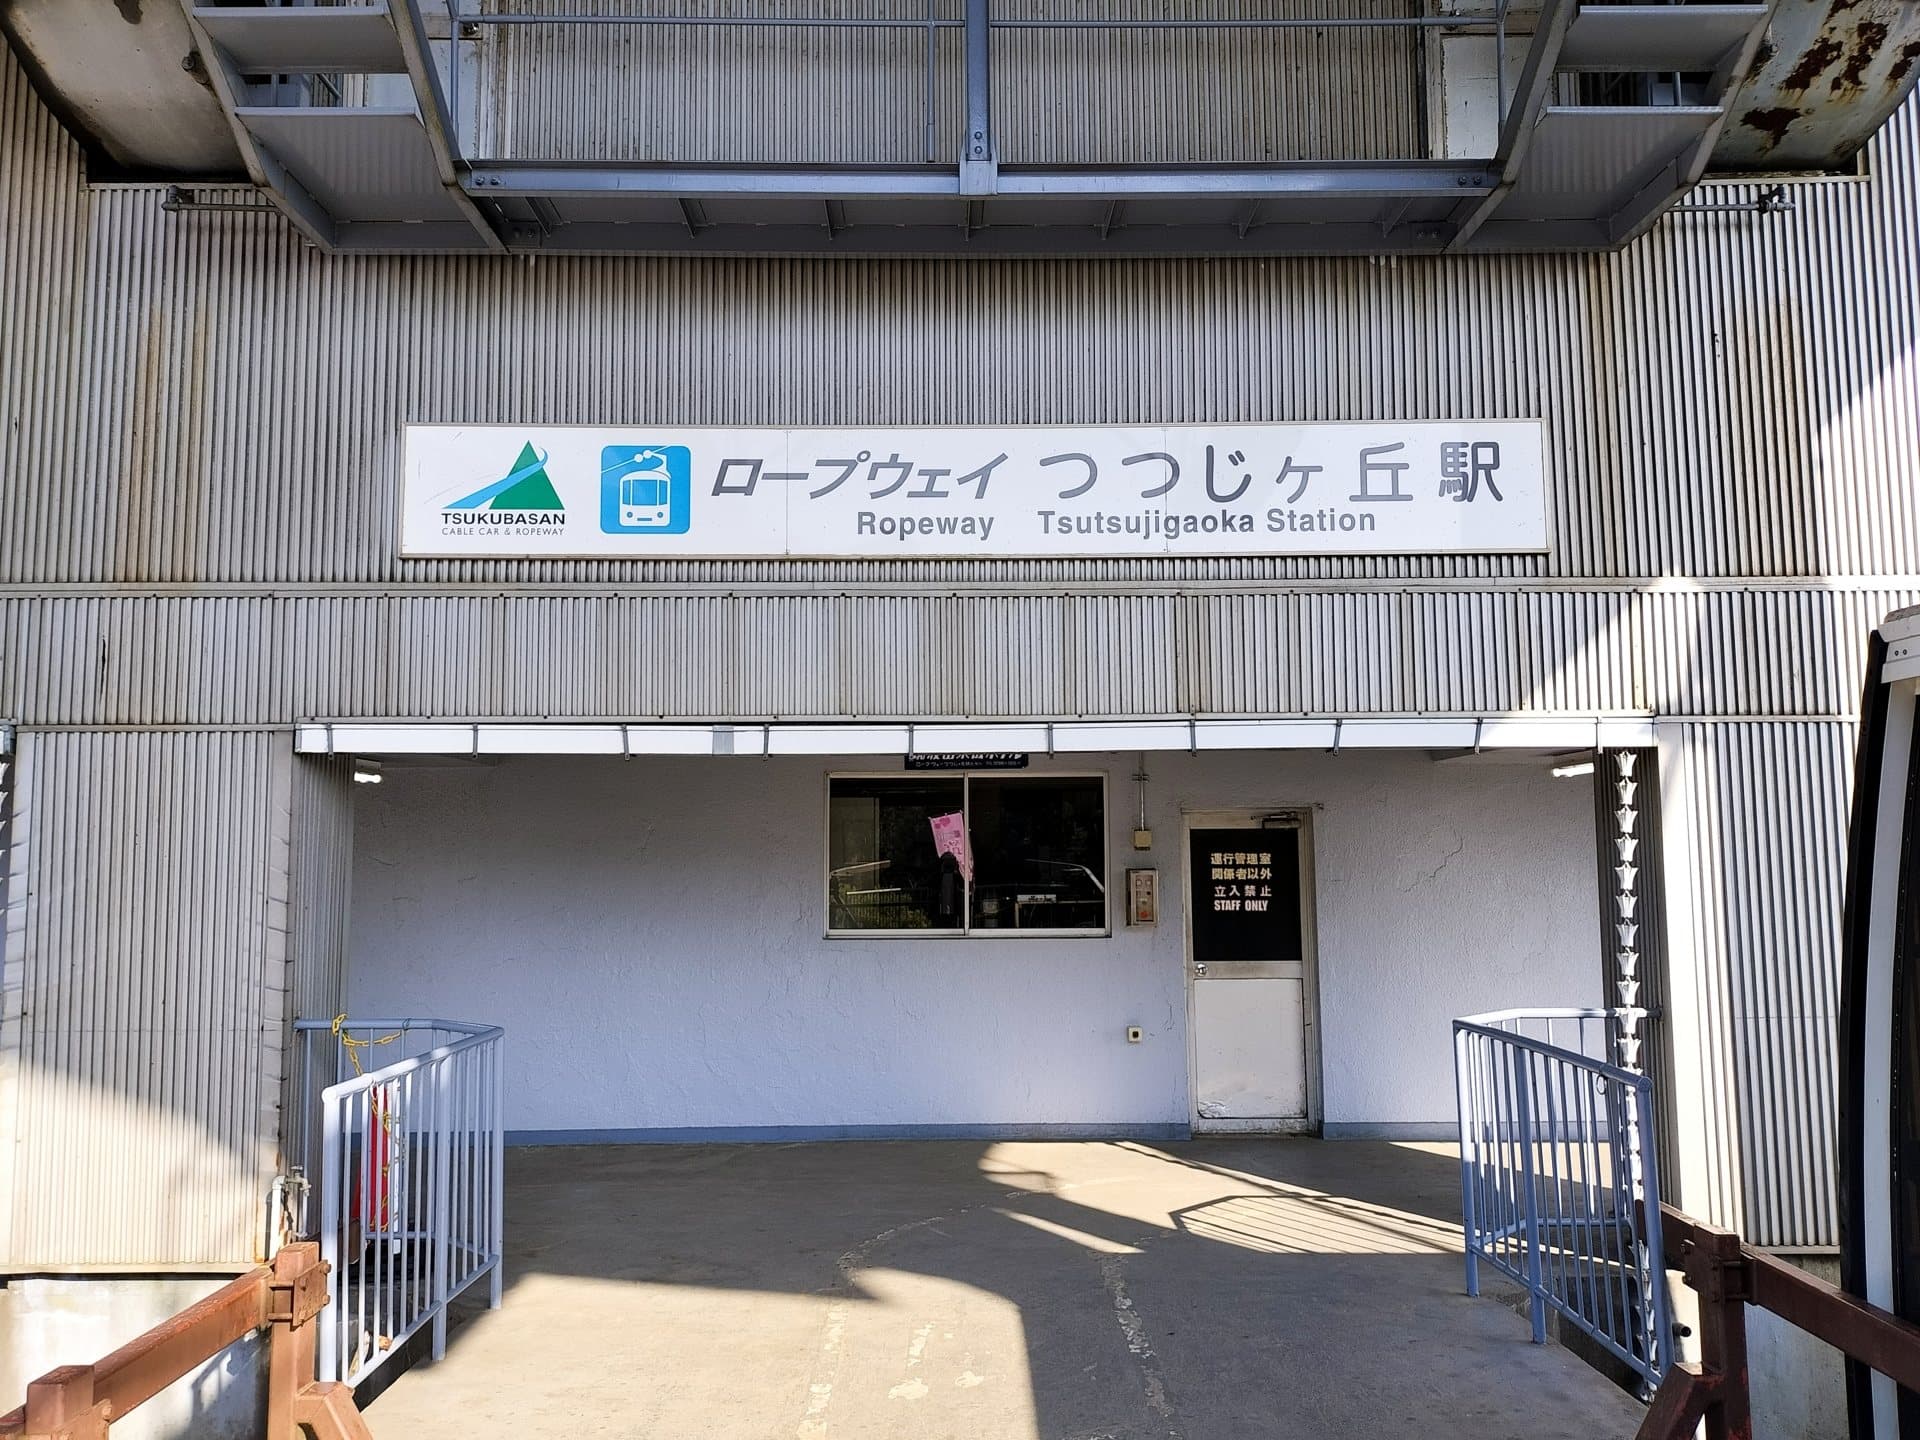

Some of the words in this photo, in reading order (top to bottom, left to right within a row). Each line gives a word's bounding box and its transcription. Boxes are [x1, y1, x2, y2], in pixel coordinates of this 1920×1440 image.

[711, 450, 1009, 500] ロープウェイ
[441, 512, 566, 525] TSUKUBASAN
[857, 511, 995, 542] Ropeway
[1038, 508, 1255, 540] Tsutsujigaoka
[1267, 507, 1375, 533] Station
[441, 527, 475, 536] CABLE
[478, 527, 500, 536] CAR
[504, 527, 511, 536] &
[515, 527, 565, 536] ROPEWAY
[1210, 852, 1272, 865] 運行管理室
[1211, 867, 1273, 881] 関係者以外
[1214, 885, 1272, 898] 立入禁止
[1213, 900, 1241, 912] STAFF
[1244, 900, 1269, 912] ONLY
